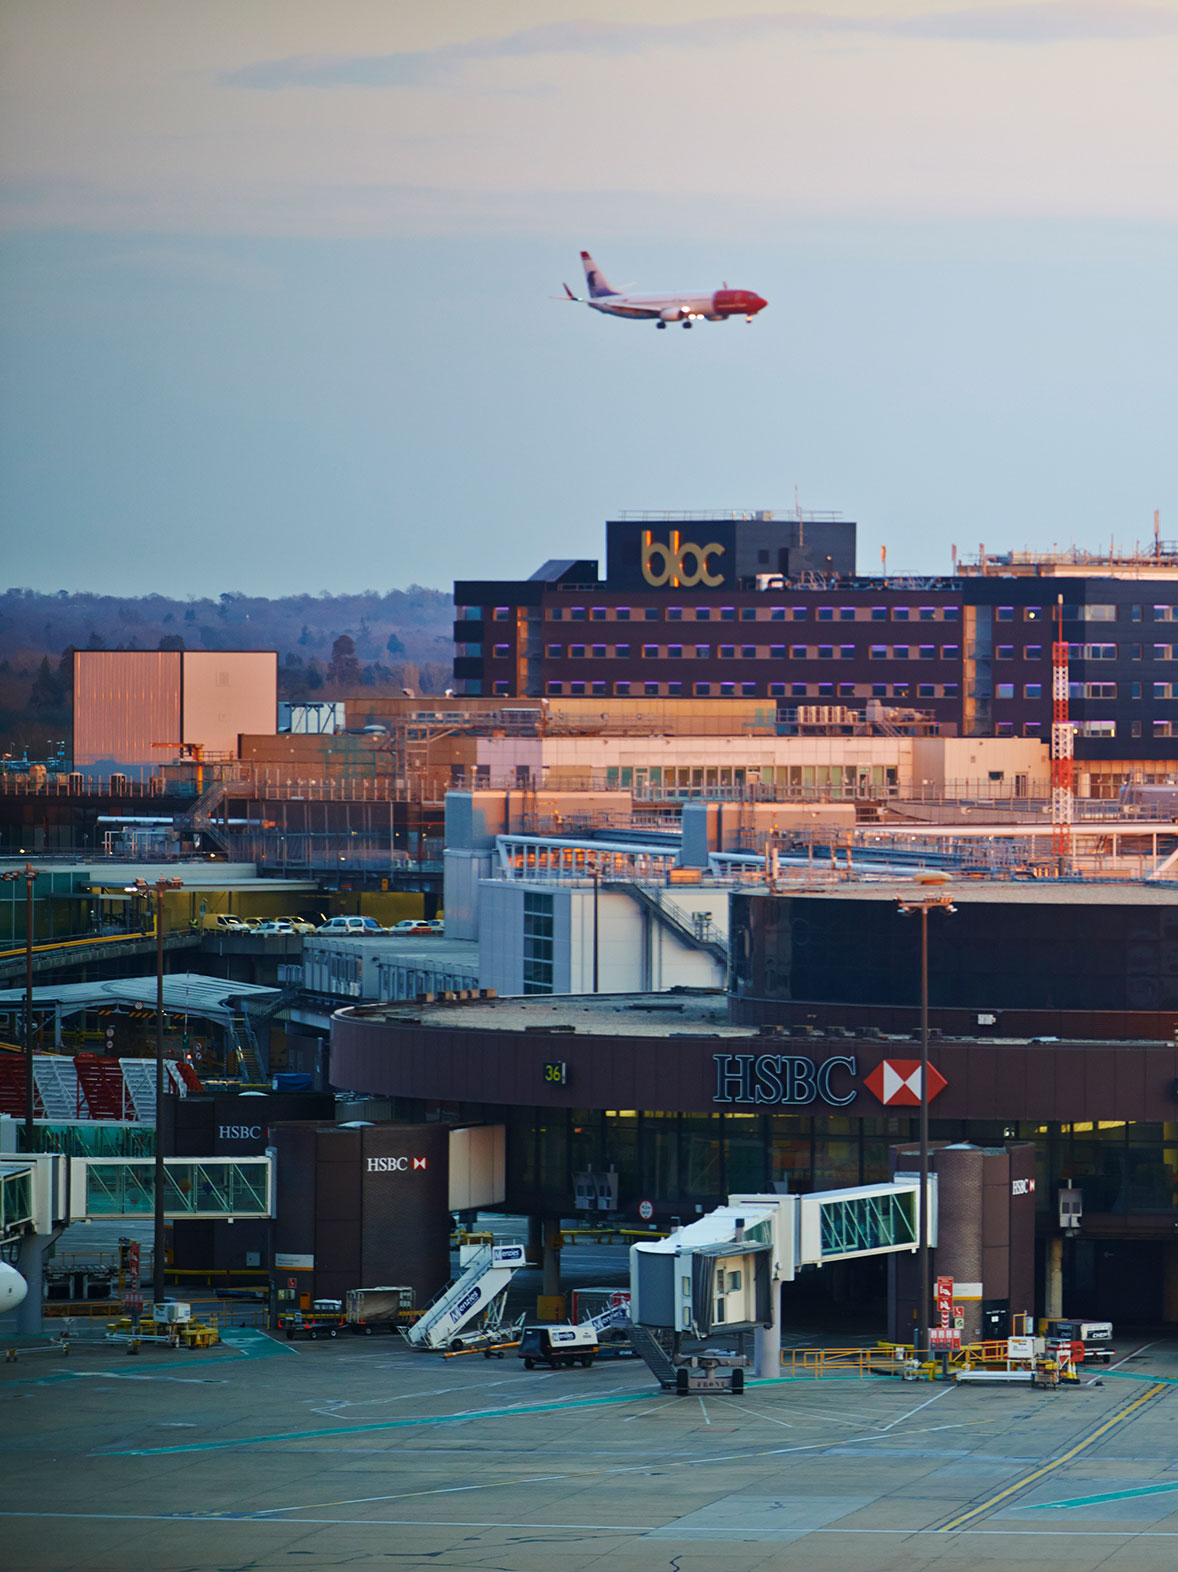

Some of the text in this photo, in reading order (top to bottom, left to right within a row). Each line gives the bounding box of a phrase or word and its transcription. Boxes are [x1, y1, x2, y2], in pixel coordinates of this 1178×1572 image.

[641, 530, 725, 587] bloc
[545, 1065, 561, 1081] 36
[712, 1054, 857, 1106] HSBC
[218, 1126, 261, 1139] HSBC
[367, 1157, 408, 1172] HSBC
[1012, 1178, 1029, 1195] HSBC
[449, 1289, 479, 1324] Menzies
